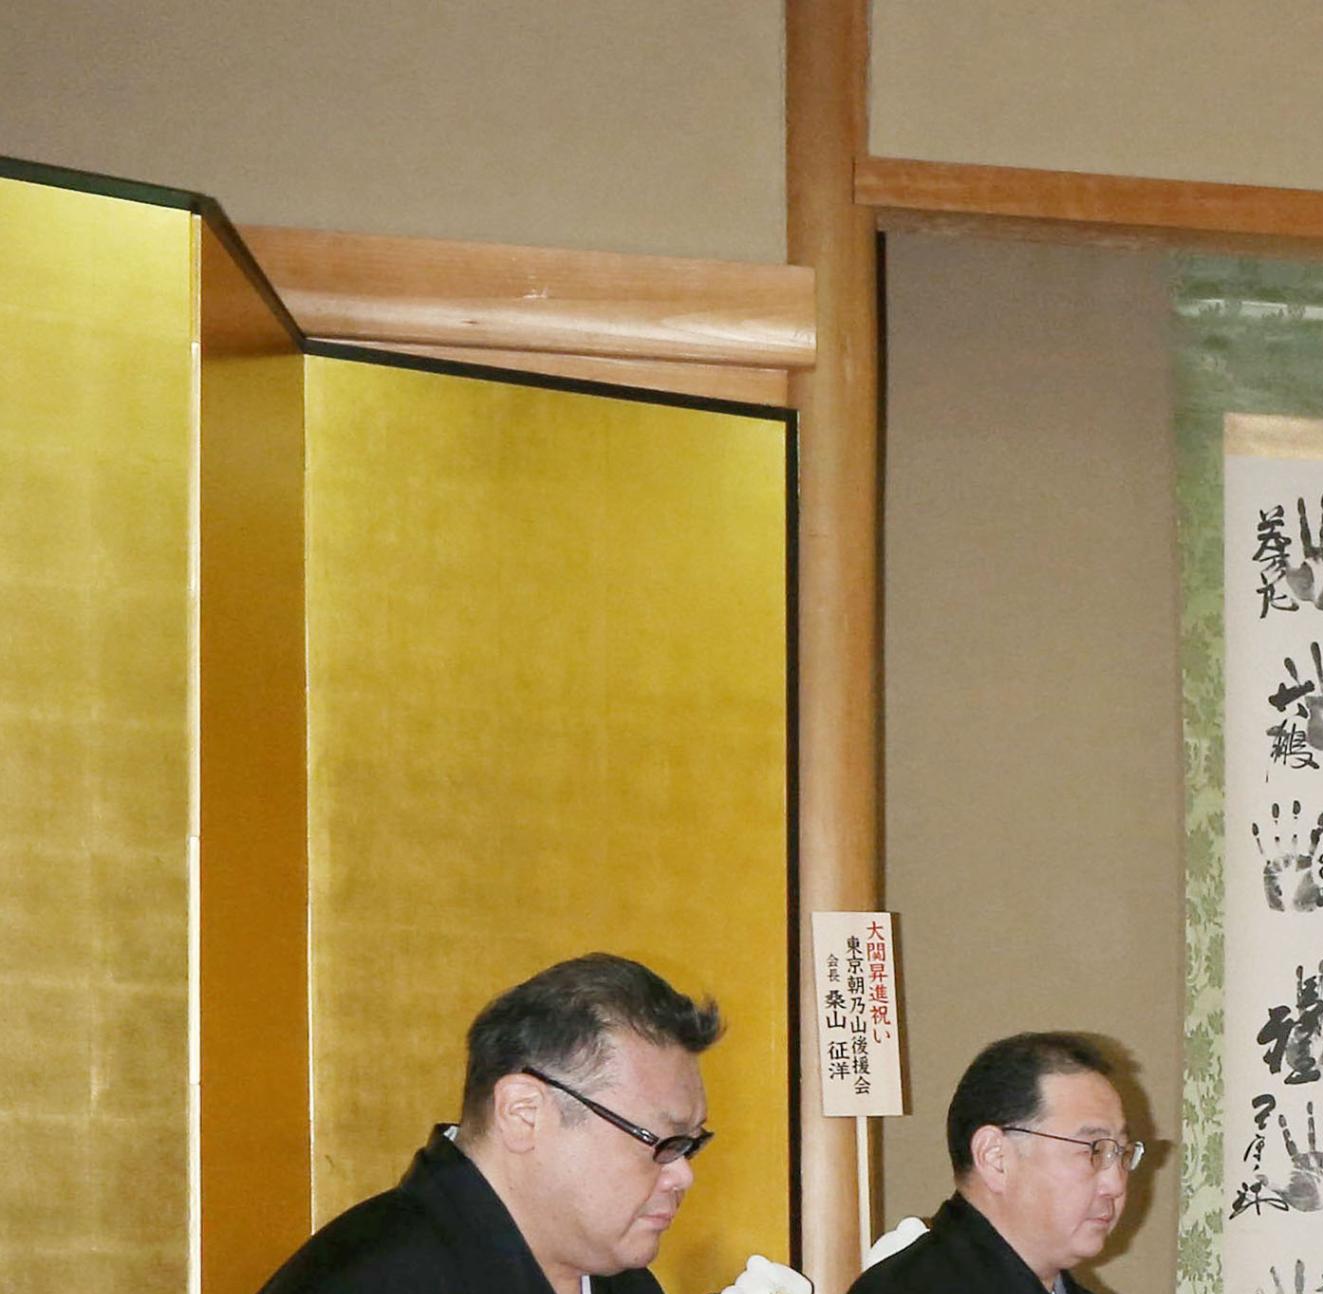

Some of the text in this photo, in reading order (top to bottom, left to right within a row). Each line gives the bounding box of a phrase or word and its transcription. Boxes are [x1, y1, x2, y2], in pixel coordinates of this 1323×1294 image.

[825, 953, 850, 1081] 会長 桑山 征洋
[846, 935, 872, 1095] 東京朝乃山後援会
[866, 921, 891, 1044] 大関昇進祝い
